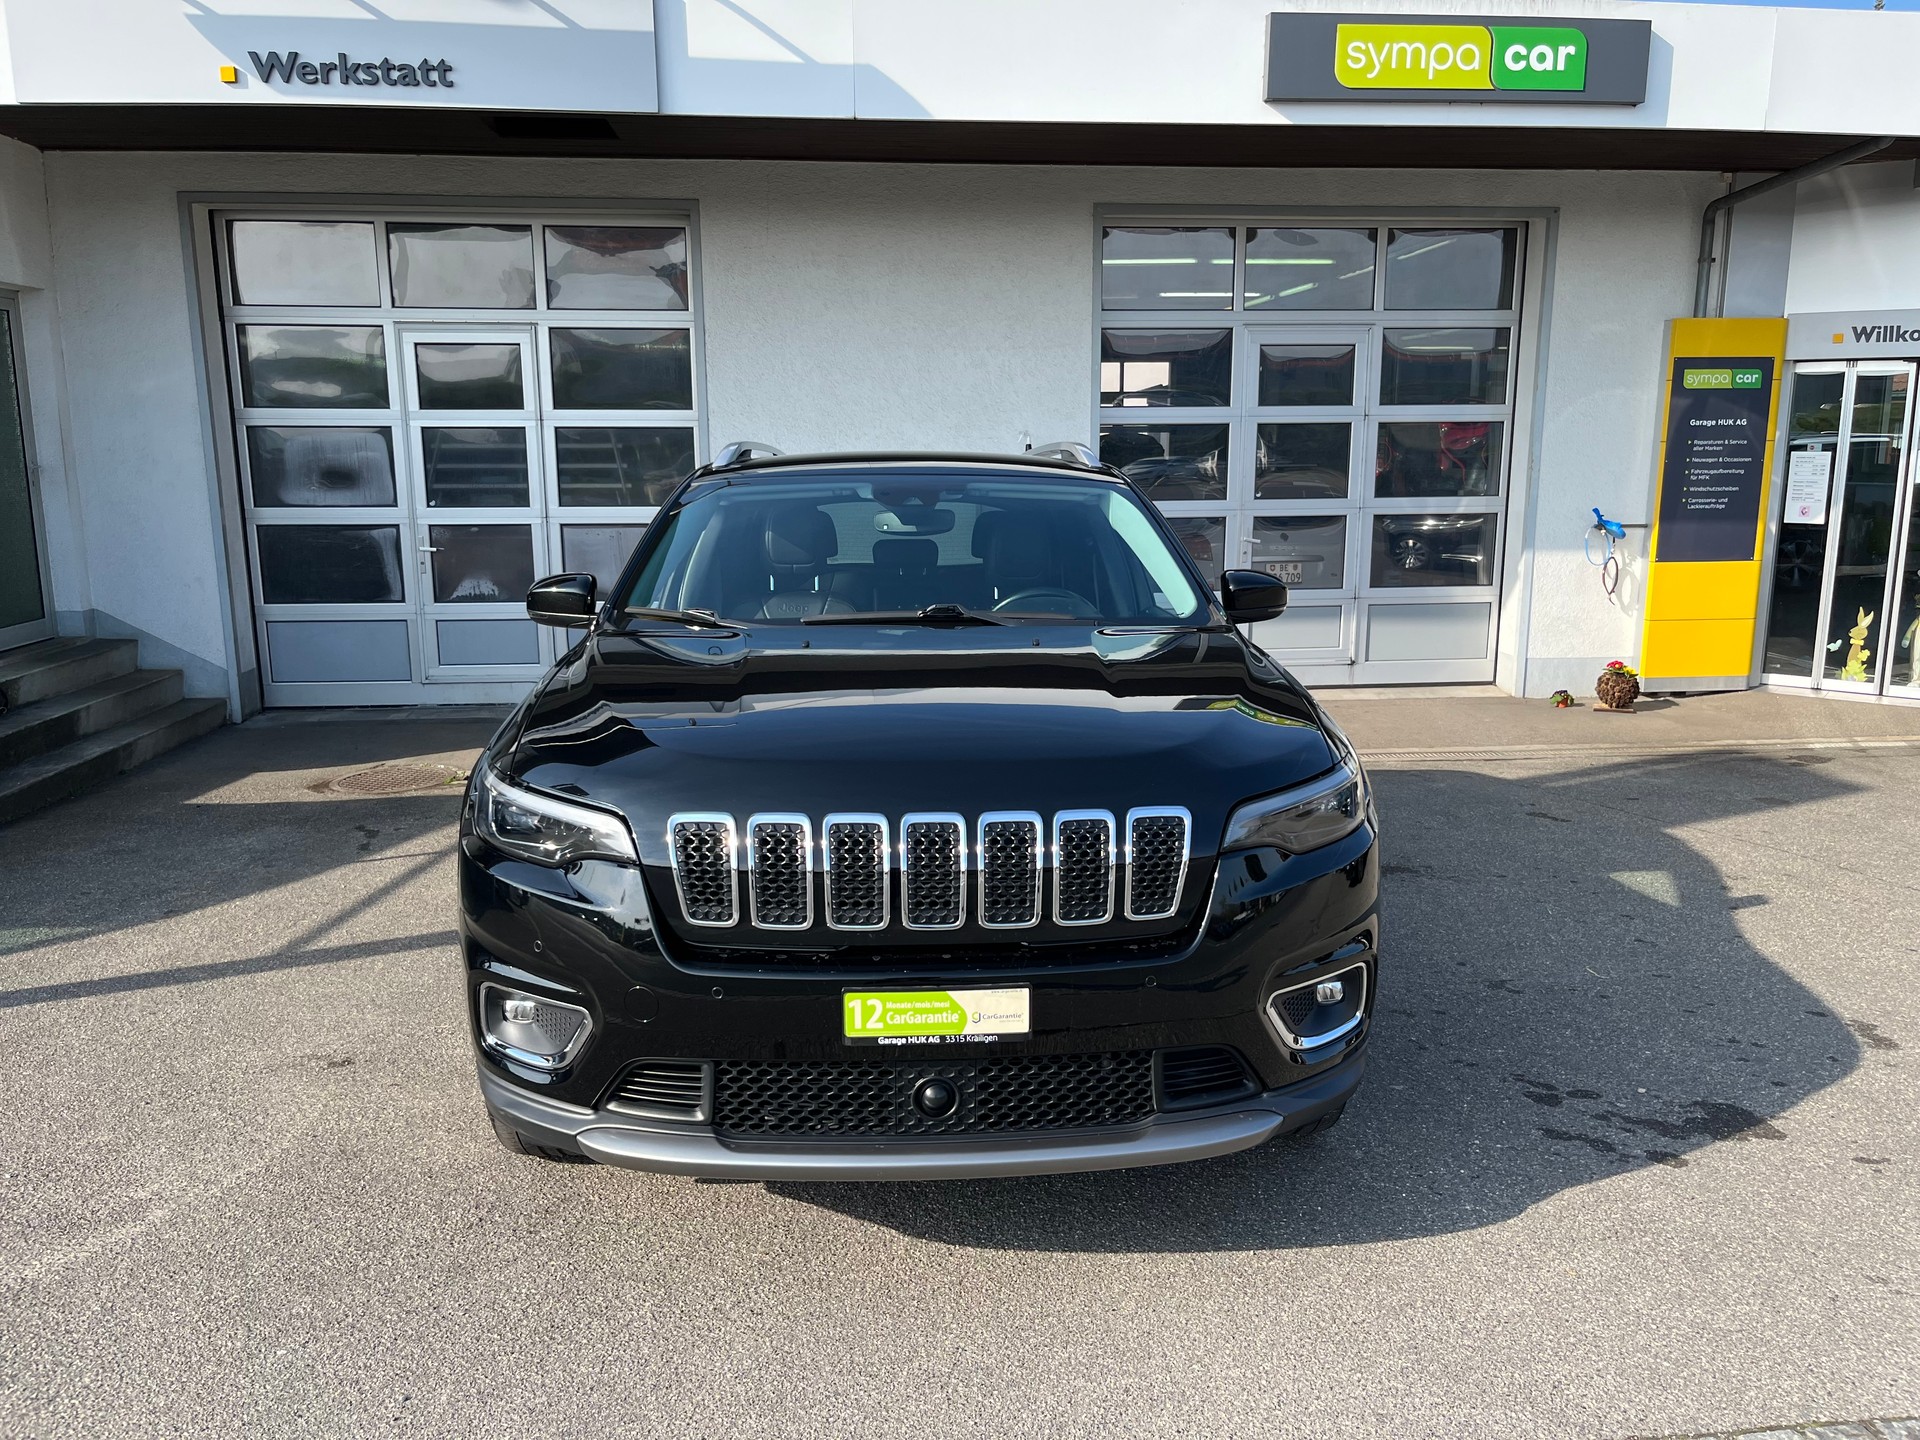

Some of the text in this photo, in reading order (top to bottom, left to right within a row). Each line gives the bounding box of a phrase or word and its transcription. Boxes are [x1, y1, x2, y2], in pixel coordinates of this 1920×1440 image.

[248, 51, 454, 87] Werkstatt
[1346, 41, 1576, 80] sympa car
[1687, 374, 1758, 386] sympa car
[1690, 419, 1716, 427] Garage
[848, 999, 884, 1029] 12
[878, 1037, 907, 1045] Garage
[908, 1036, 927, 1044] HUK
[928, 1035, 940, 1043] AG
[945, 1035, 965, 1043] 3315
